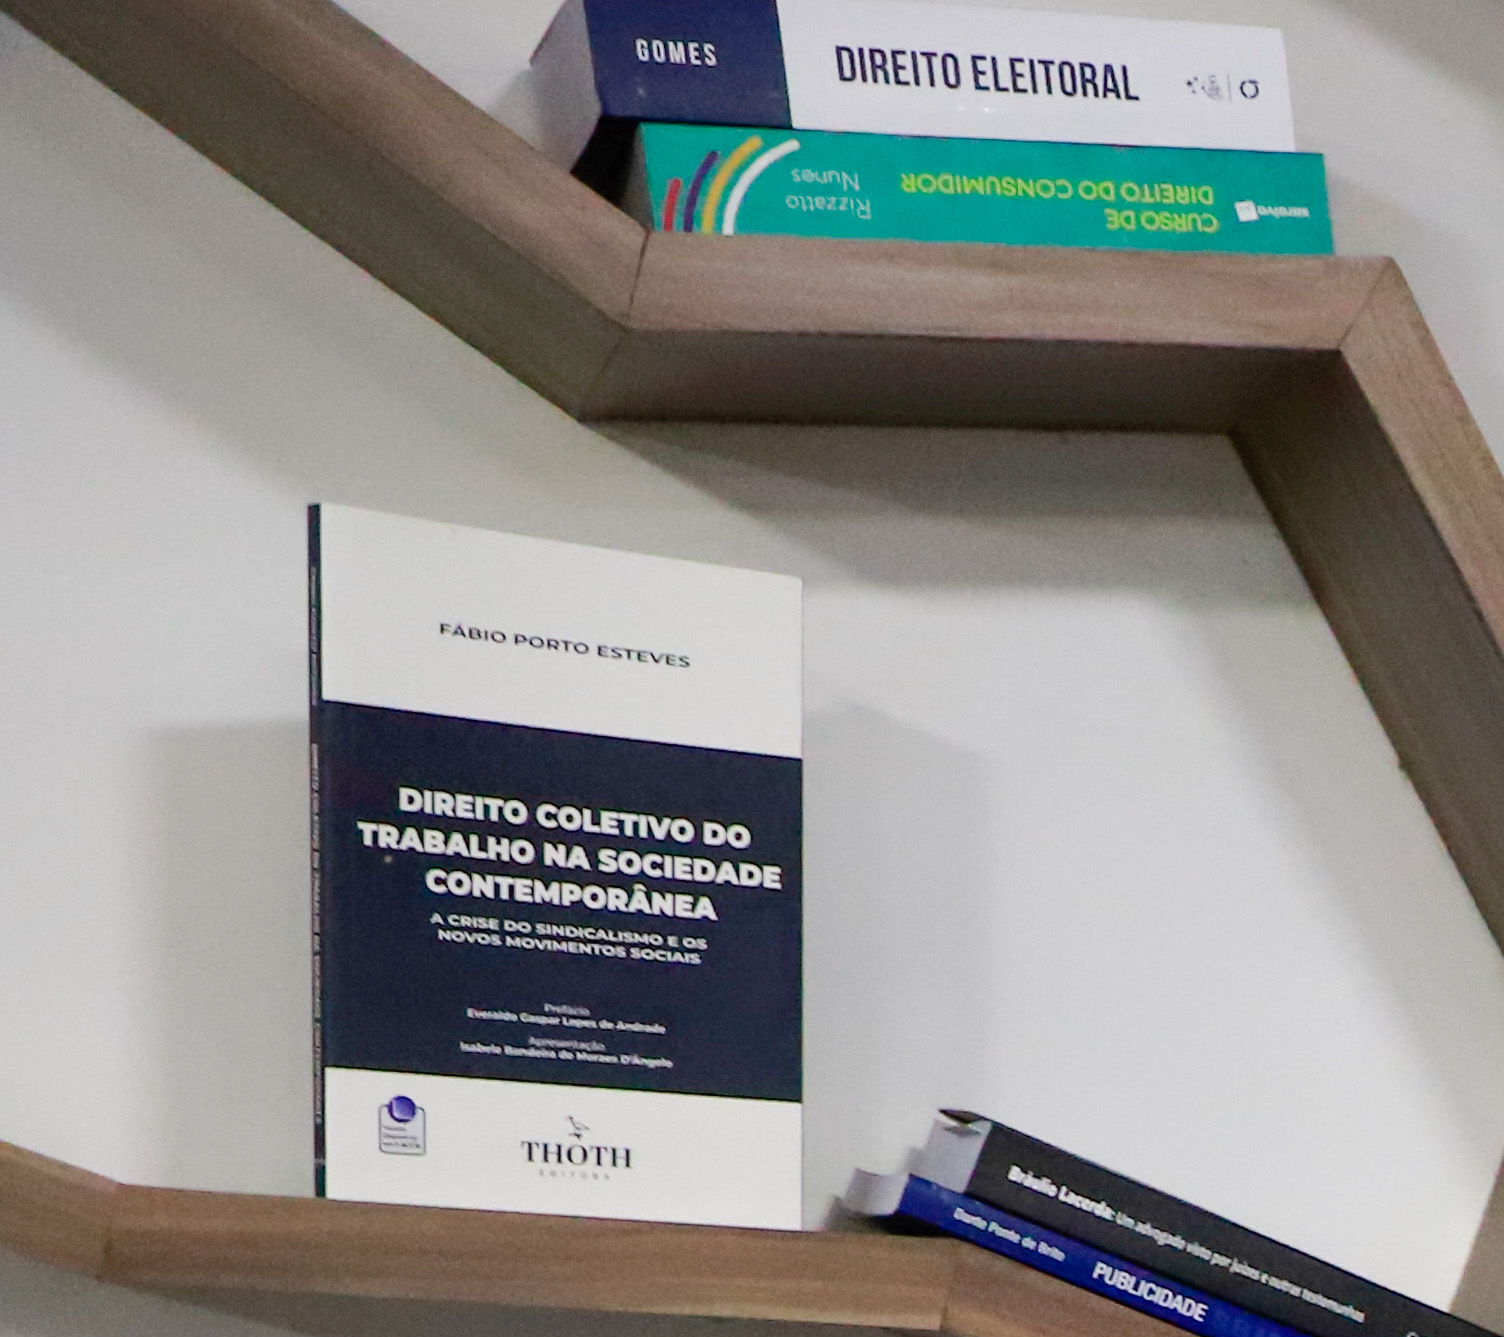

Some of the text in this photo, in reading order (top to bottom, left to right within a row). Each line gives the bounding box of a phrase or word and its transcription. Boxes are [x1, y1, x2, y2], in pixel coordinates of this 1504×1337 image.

[635, 38, 717, 67] GOMES
[834, 45, 1140, 102] DIREITO ELEITORAL
[790, 167, 861, 192] Nunes
[899, 171, 1215, 206] DIREITO DO CONSUMIDOR
[784, 194, 872, 221] Rizzatto
[1104, 207, 1219, 234] CURSO DE
[1258, 204, 1310, 219] saraiva
[439, 622, 691, 668] FÁBIO PORTO ESTEVES
[398, 786, 752, 849] DIREITO COLETIVO DO
[356, 820, 783, 890] TRABALHO NA SOCIEDADE
[425, 868, 719, 921] CONTEMPORÂNEA
[429, 912, 709, 951] A CRISE DO SINDICALISMO E OS
[437, 929, 702, 965] NOVOS MOVIMENTOS SOCIAIS
[526, 1141, 631, 1168] THOTH
[1092, 1261, 1209, 1323] PUBLICIDADE
